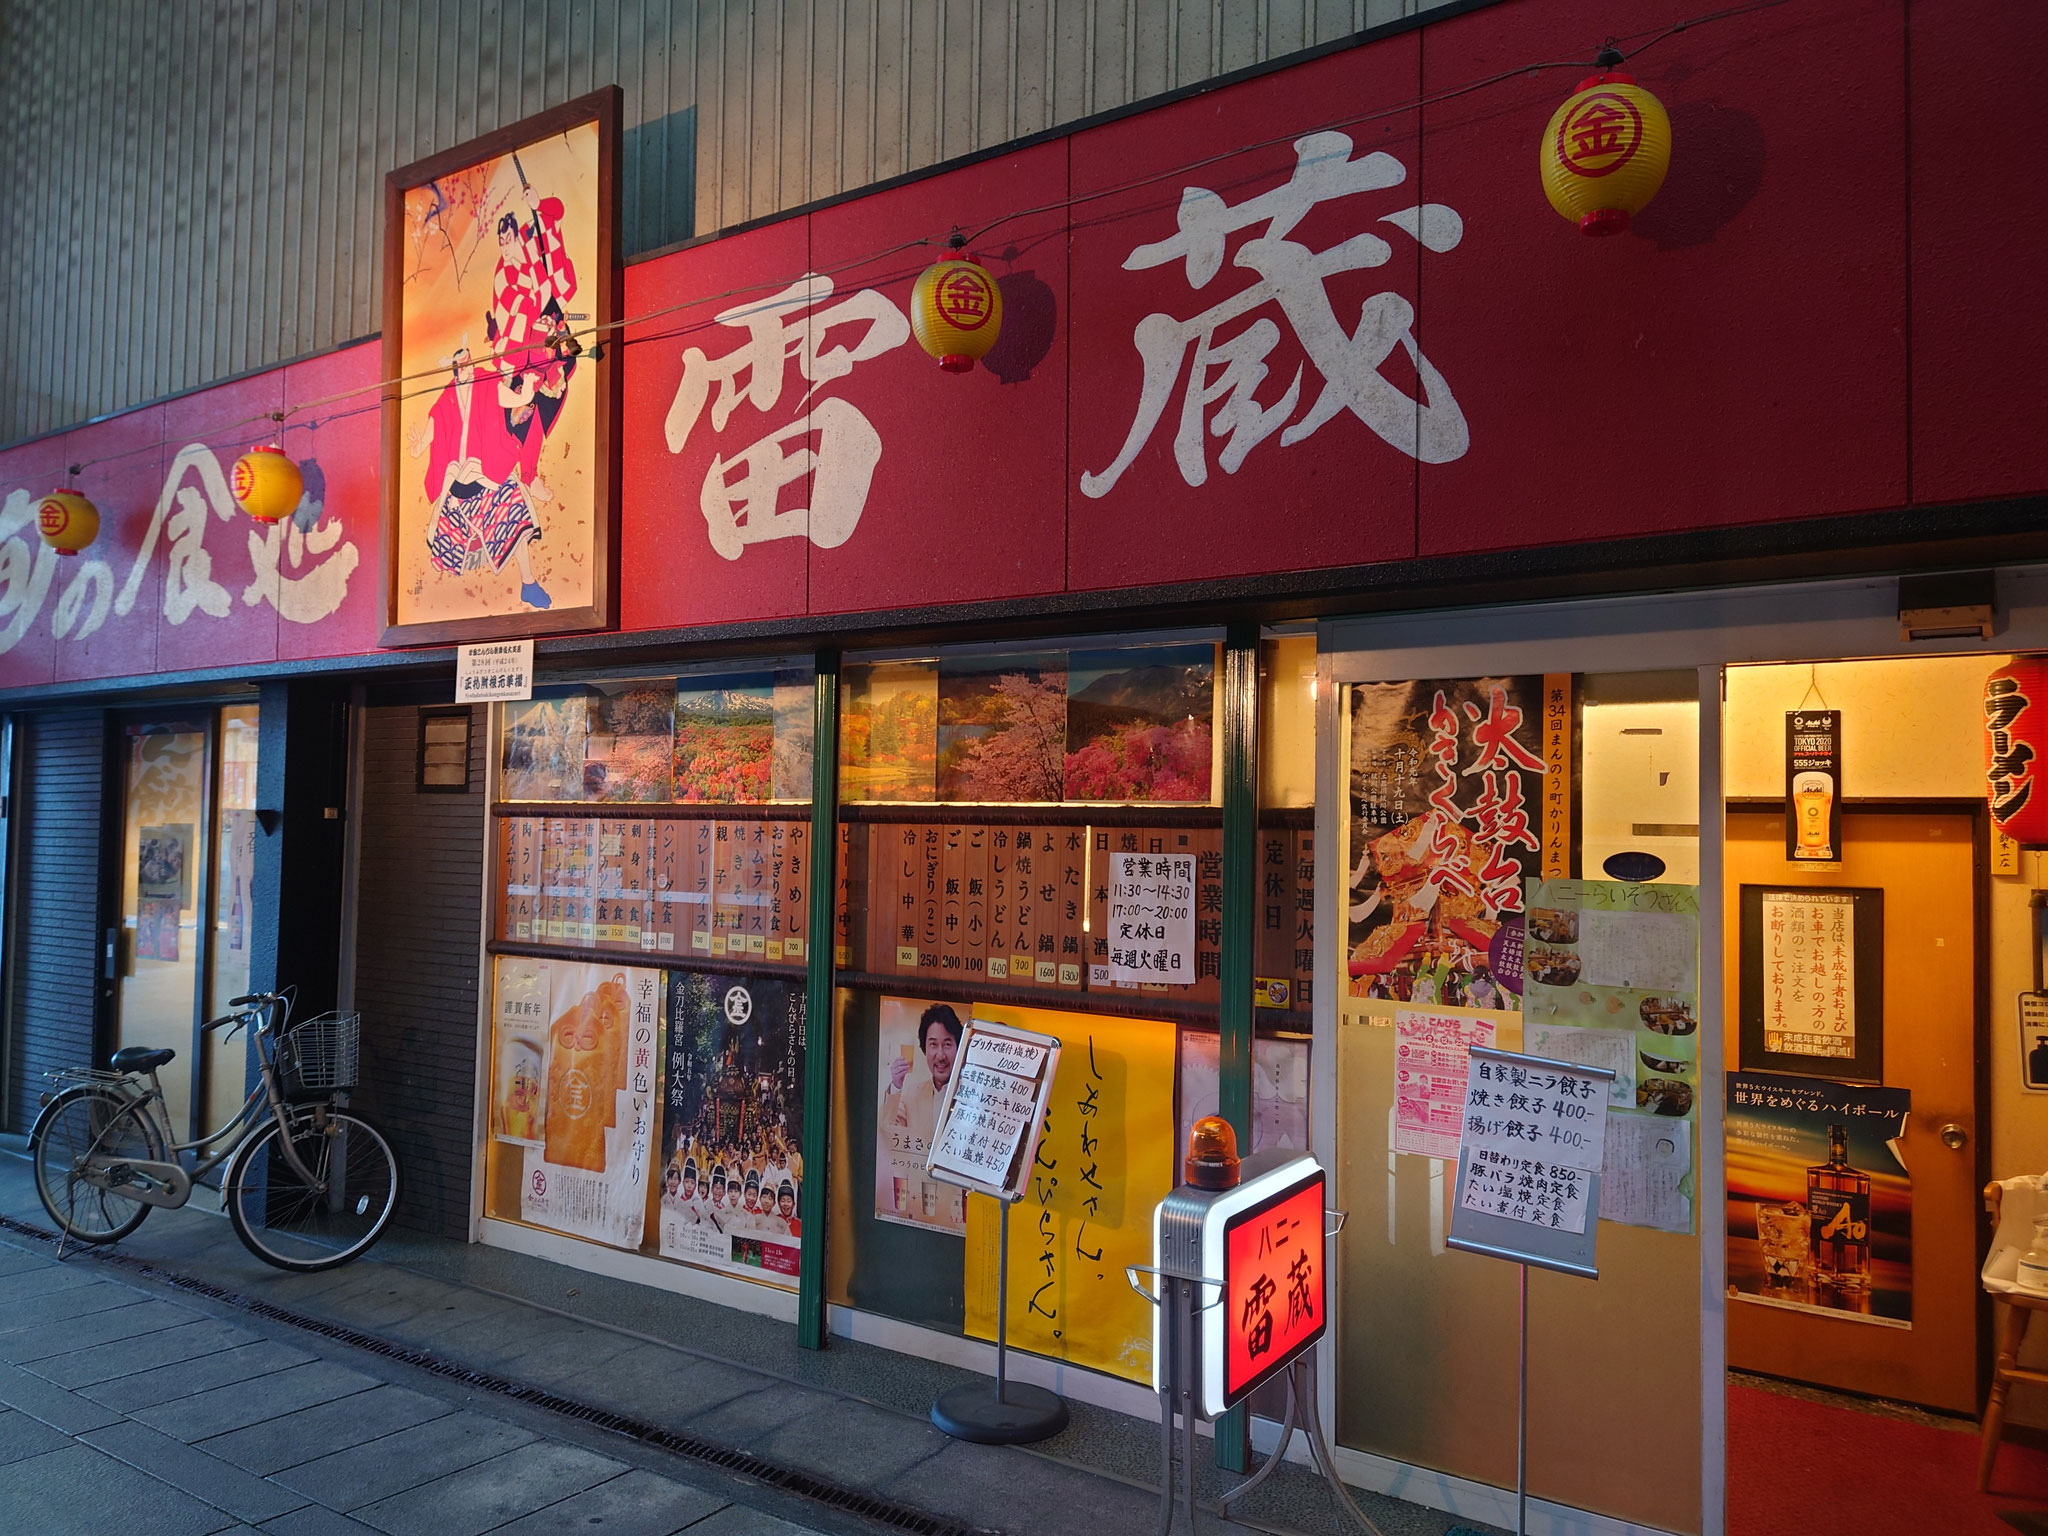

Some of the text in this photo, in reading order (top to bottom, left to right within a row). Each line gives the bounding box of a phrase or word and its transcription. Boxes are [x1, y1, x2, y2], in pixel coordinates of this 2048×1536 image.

[1570, 100, 1629, 162] 金
[946, 276, 984, 321] 金
[664, 131, 1470, 560] 雷蔵
[1408, 748, 1418, 786] 令和元年
[1984, 676, 2036, 824] ラーメン
[1462, 685, 1549, 913] 太鼓台
[1548, 689, 1567, 877] 第34回まんのう町かりんまつ
[519, 823, 531, 915] 肉うどん
[629, 824, 641, 921] 刺身定食
[662, 824, 674, 924] ハンバーグ定食
[696, 825, 709, 926] カレーライス
[713, 826, 728, 928] 親子丼
[732, 826, 746, 929] 焼きそば
[751, 826, 765, 930] オムライス
[769, 826, 784, 932] おにぎり定食
[789, 826, 803, 933] やきめし
[901, 829, 916, 942] 冷し中華
[991, 830, 1008, 948] 冷しうどん
[1015, 832, 1032, 950] 鍋焼うどん
[1123, 857, 1192, 882] 営業時間
[1265, 840, 1285, 930] 定休日
[1039, 833, 1056, 953] よせ鍋
[1062, 832, 1081, 954] 水たき鍋
[1094, 833, 1109, 956] 日本酒
[1199, 851, 1222, 980] 営業時間
[1768, 894, 1849, 903] 法律で決められています
[611, 928, 623, 936] 1500
[643, 938, 655, 946] 1000
[694, 936, 703, 944] 700
[713, 942, 724, 950] 600
[1120, 922, 1166, 939] 定休日
[1295, 857, 1314, 1004] 毎週火曜日
[920, 953, 938, 968] 250
[942, 955, 960, 969] 200
[964, 957, 983, 971] 100
[991, 961, 1007, 974] 400
[1015, 959, 1029, 971] 900
[1039, 967, 1055, 977] 1600
[1062, 969, 1079, 982] 1300
[1094, 969, 1109, 980] 500
[1110, 947, 1181, 972] 毎週火曜日
[1770, 905, 1787, 1028] お断りしております。
[1790, 906, 1806, 1003] 酒類のご注文を
[1810, 907, 1826, 1031] お車でお越しの方の
[1831, 907, 1849, 1033] 当店は、未成年者および
[504, 1001, 541, 1017] 謹賀新年
[674, 981, 684, 1047] 金刀比羅宮
[630, 978, 653, 1187] 幸福の黄色いお守り
[670, 1051, 684, 1107] 例大祭
[1010, 1080, 1029, 1096] 400
[1469, 1089, 1547, 1114] 焼き餃子
[1480, 1062, 1596, 1099] 自家製ニラ餃子
[955, 1109, 996, 1133] 豚バラ焼肉
[997, 1121, 1016, 1136] 600
[1734, 1091, 1899, 1119] 世界をめぐるハイボール
[947, 1127, 1012, 1156] たい煮付 450
[1468, 1115, 1543, 1142] 揚げ餃子
[941, 1141, 1005, 1172] たい塩焼 450
[1076, 1034, 1104, 1280] しあわせさん。
[1480, 1150, 1546, 1177] 日替わり定食
[1468, 1178, 1566, 1213] たい塩焼定食
[1470, 1162, 1579, 1200] 豚バラ焼肉定食
[1466, 1193, 1565, 1228] たい煮付定食
[1821, 1202, 1866, 1239] Ao
[1258, 1217, 1300, 1261] ハニー
[1241, 1249, 1314, 1362] 雷蔵
